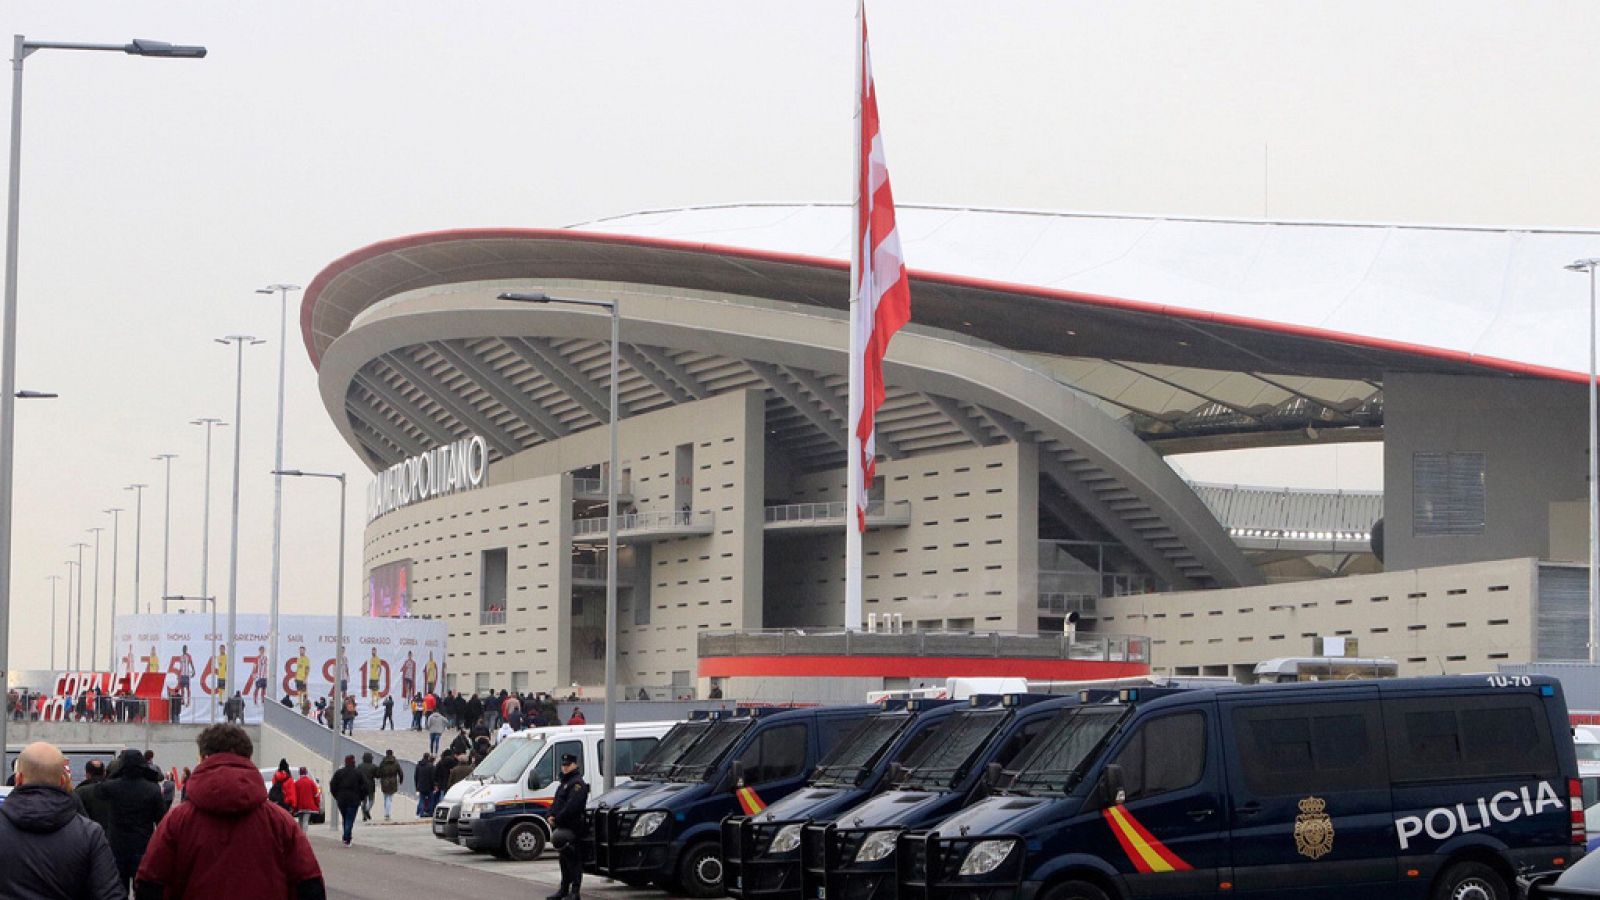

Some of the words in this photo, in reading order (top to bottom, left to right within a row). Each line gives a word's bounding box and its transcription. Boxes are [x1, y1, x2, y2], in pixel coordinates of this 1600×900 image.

[242, 655, 261, 695] 7
[1487, 675, 1532, 687] 1U-70
[1395, 780, 1564, 850] POLICIA
